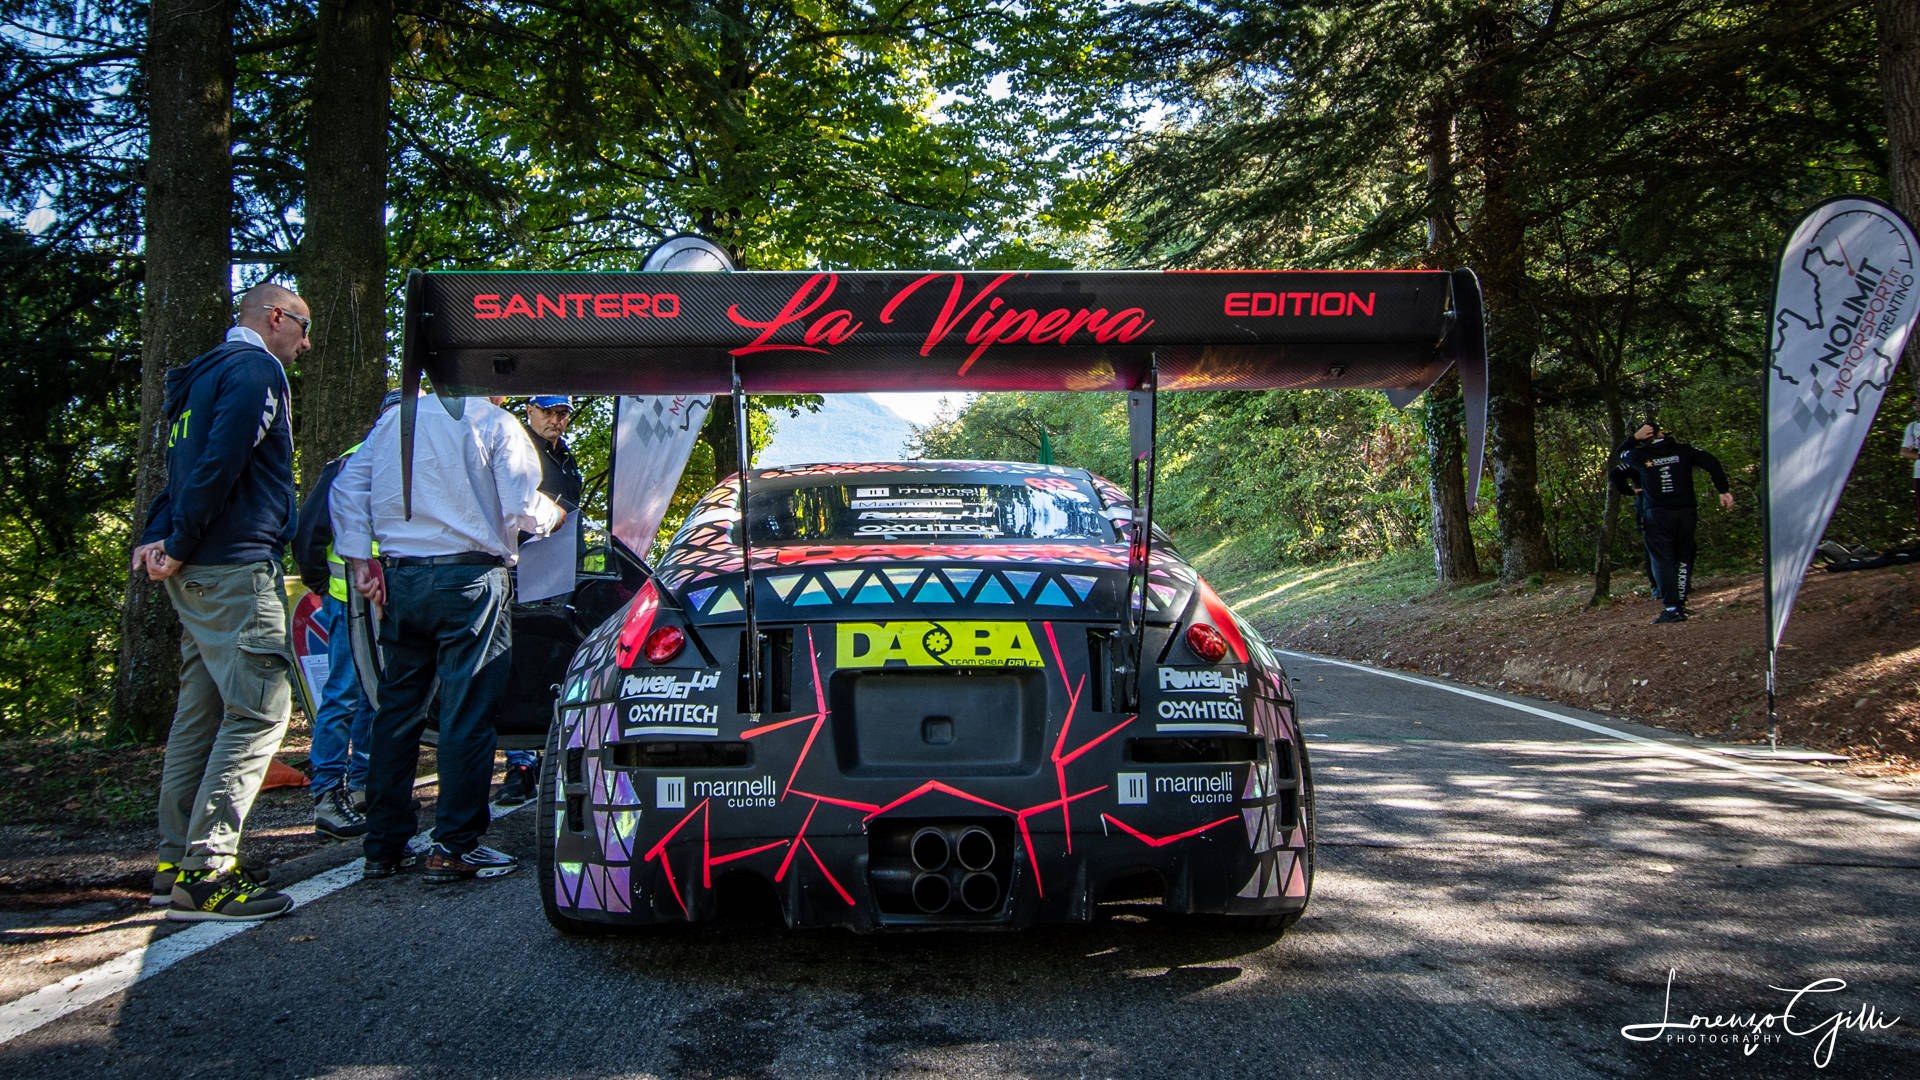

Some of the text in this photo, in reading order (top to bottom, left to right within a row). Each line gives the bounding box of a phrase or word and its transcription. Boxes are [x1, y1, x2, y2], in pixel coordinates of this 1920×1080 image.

[1818, 257, 1883, 369] NOLIMIT
[1873, 273, 1915, 342] TRENTINO
[473, 273, 1376, 378] SANTERO La Vipera EDITION
[1831, 266, 1902, 399] MOTORSPORT.IT
[858, 524, 1000, 533] OXYHTECH
[628, 703, 718, 723] OXYHTECH
[1158, 700, 1243, 720] OXYHTECH
[692, 776, 777, 798] marinelli
[1155, 771, 1233, 793] marinelli
[727, 798, 776, 808] cucine
[1190, 793, 1233, 804] cucine
